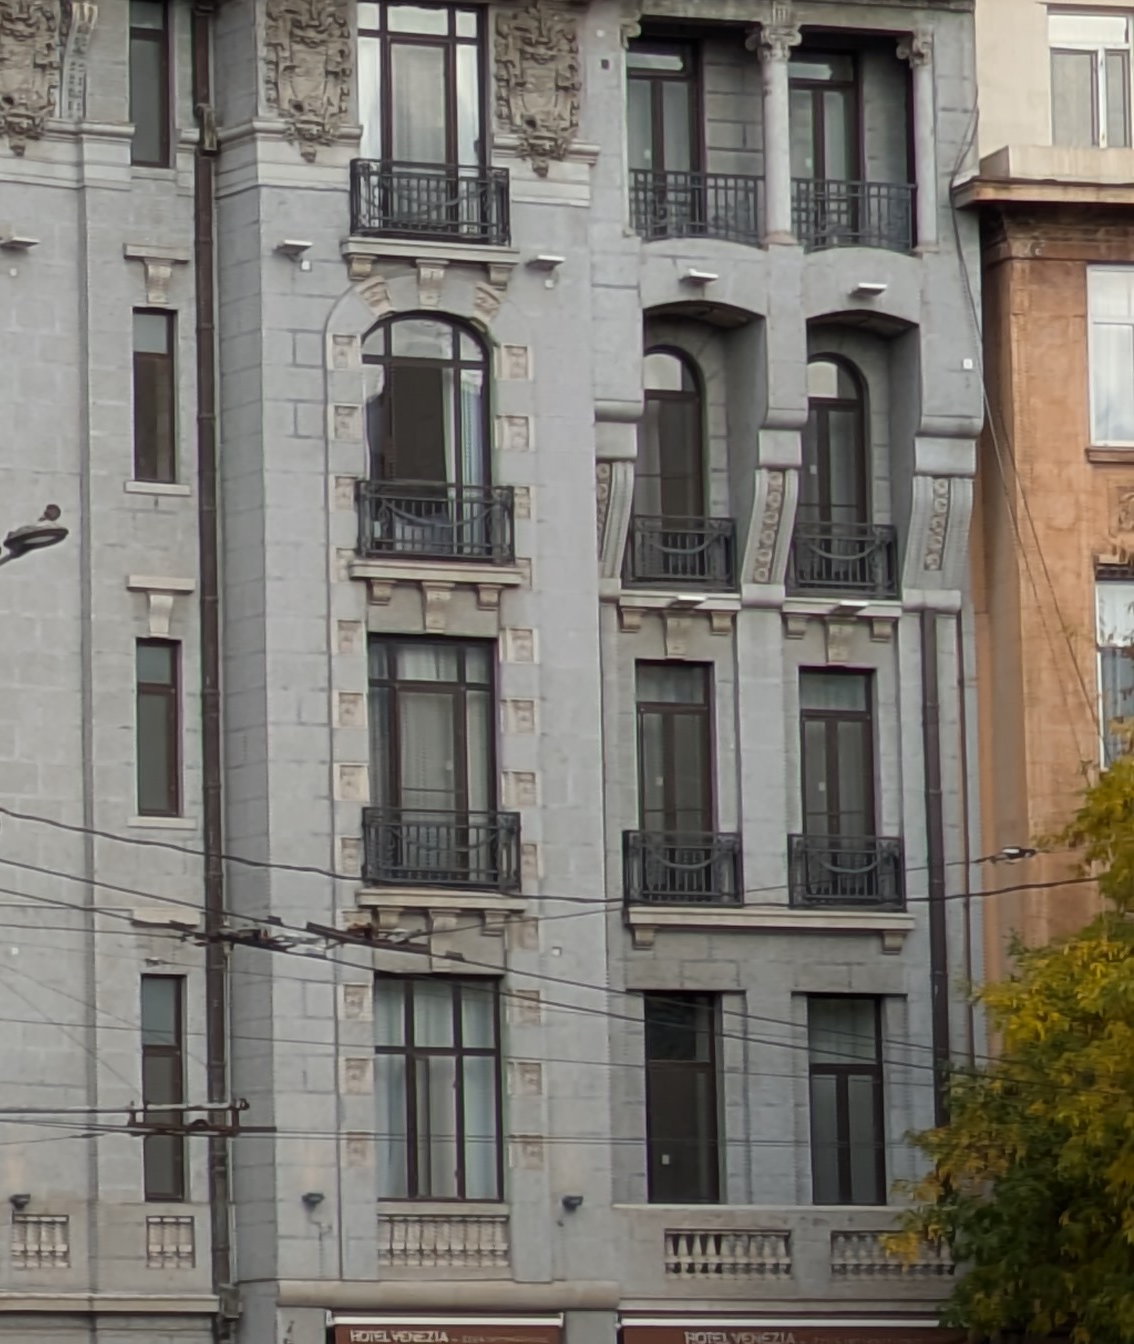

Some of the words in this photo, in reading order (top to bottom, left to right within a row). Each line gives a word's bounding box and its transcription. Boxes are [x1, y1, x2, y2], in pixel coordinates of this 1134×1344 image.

[350, 1330, 391, 1342] HOTEL
[391, 1330, 449, 1342] VENEZIA
[684, 1331, 729, 1344] HOTEL
[731, 1331, 795, 1344] VENEZIA
